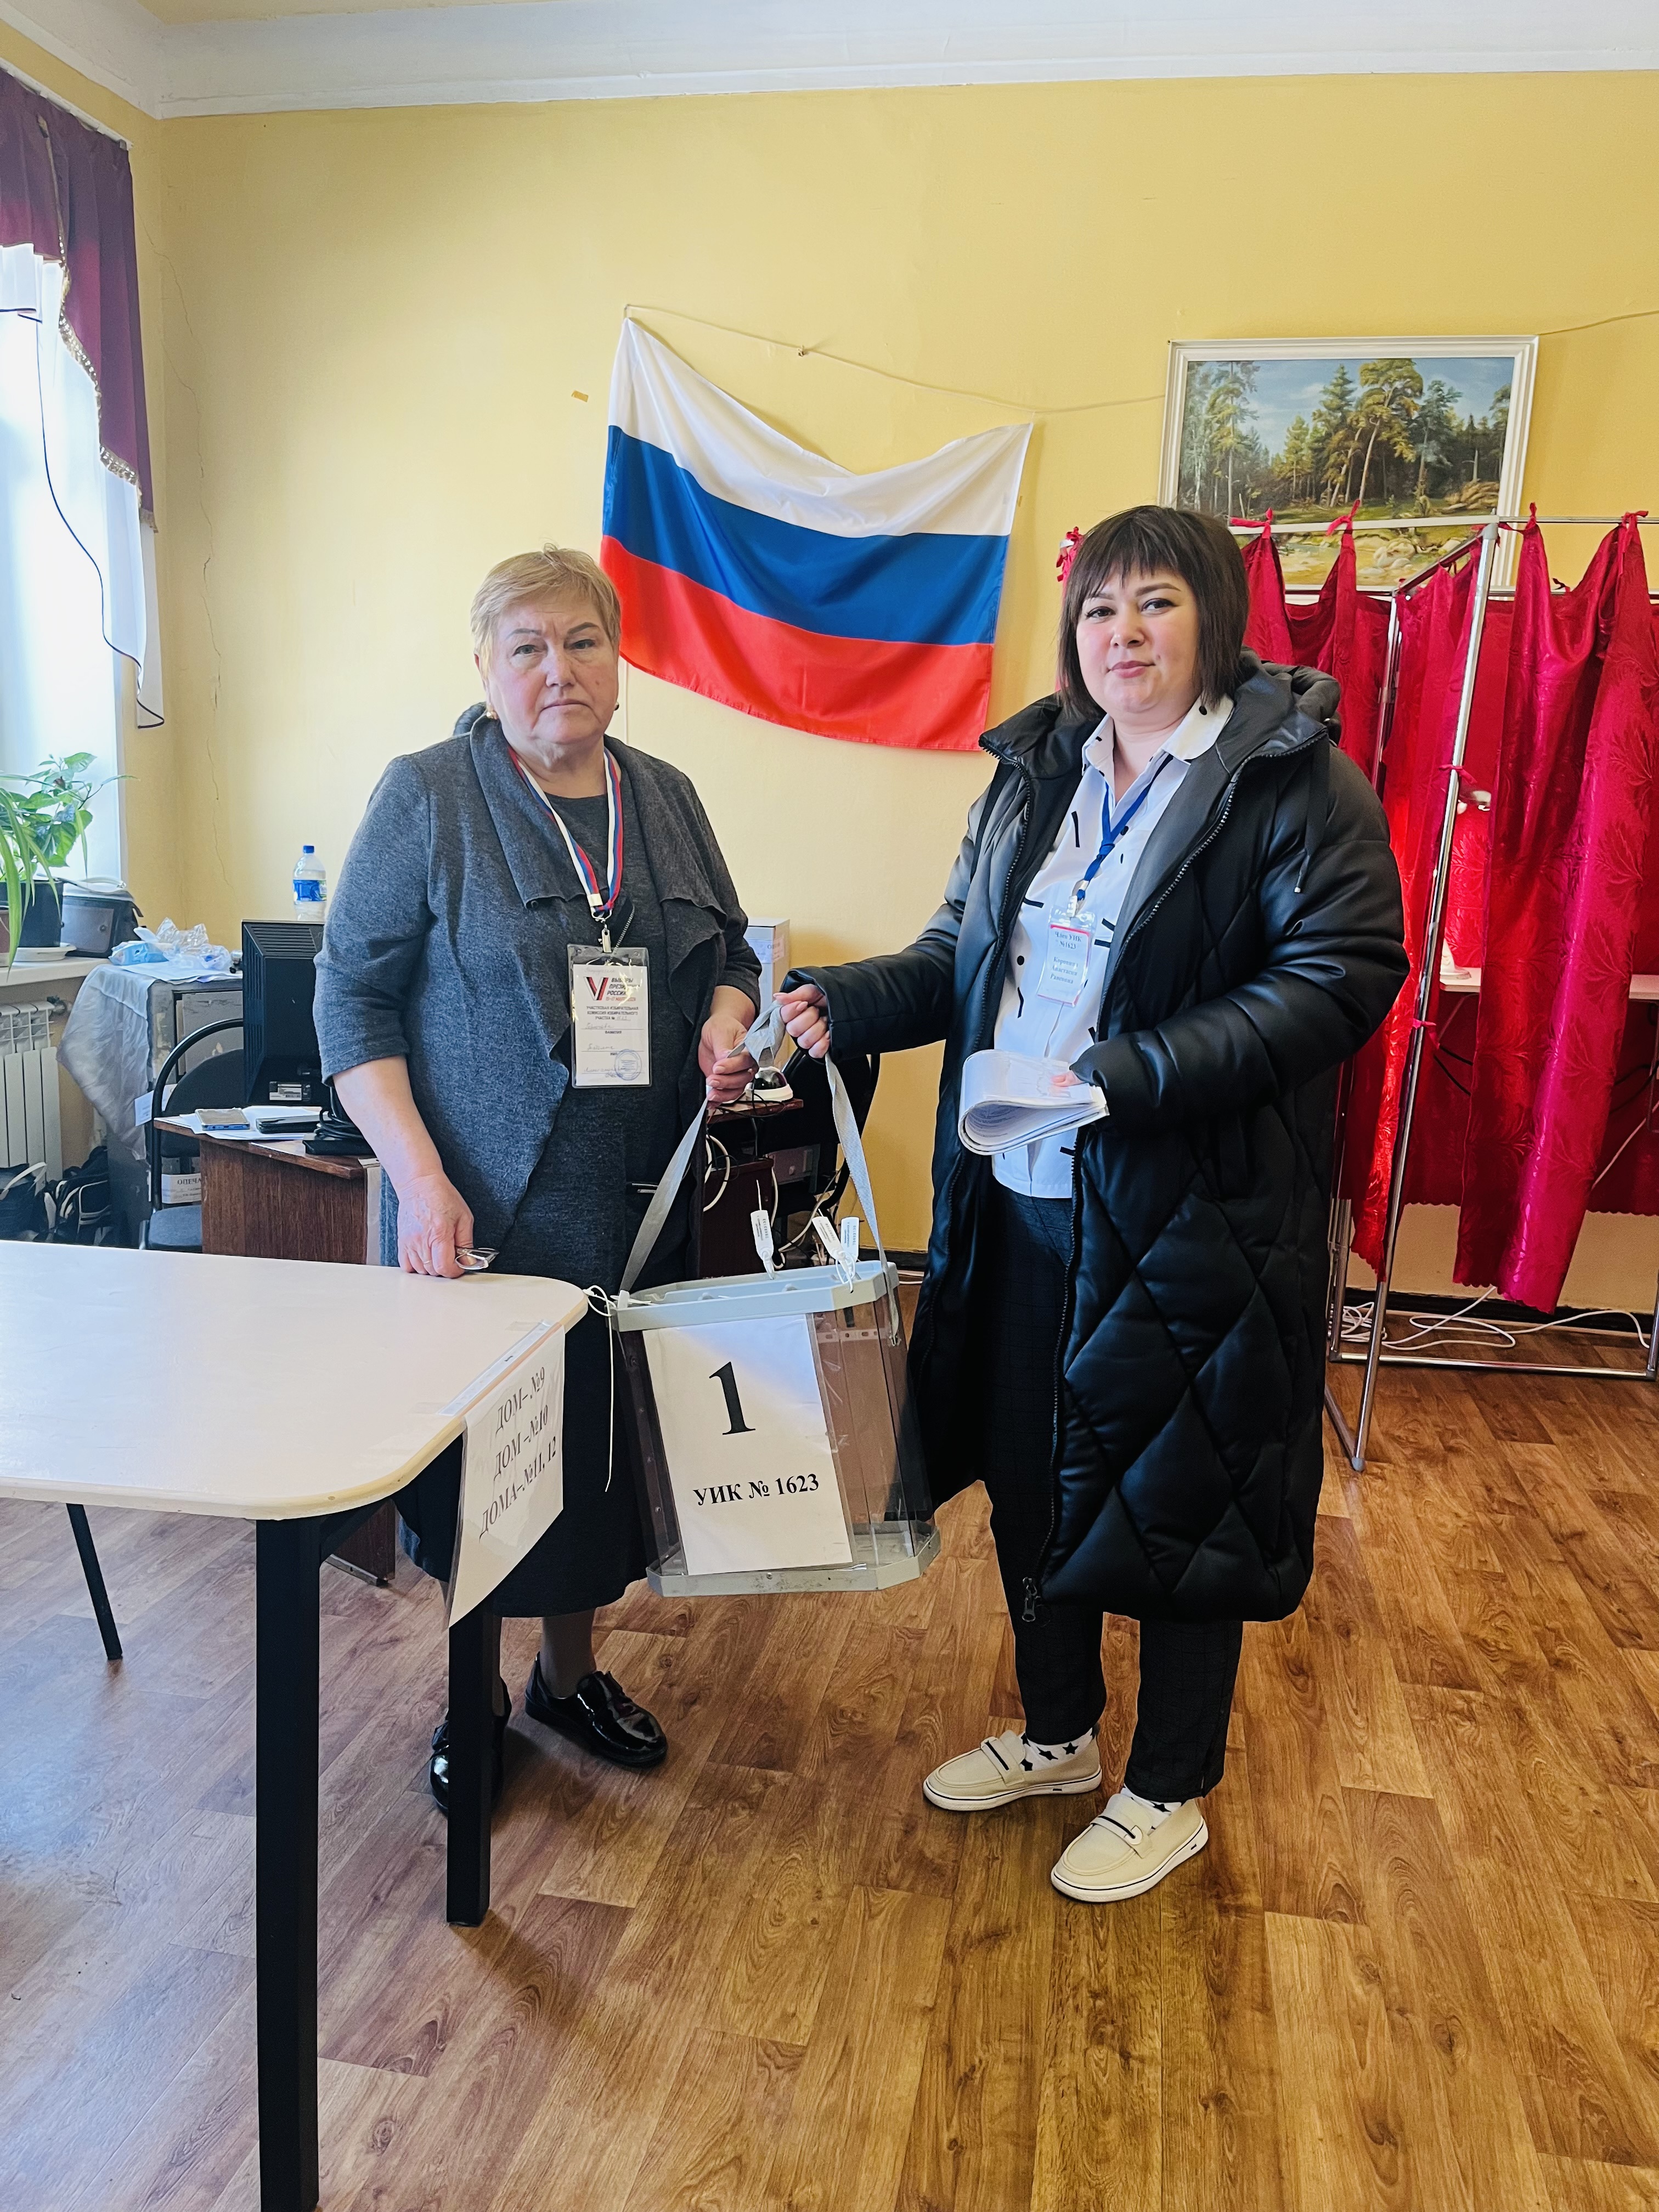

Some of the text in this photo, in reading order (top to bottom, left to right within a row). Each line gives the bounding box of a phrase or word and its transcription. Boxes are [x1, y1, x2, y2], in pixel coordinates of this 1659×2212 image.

[530, 1367, 545, 1400] №9
[709, 1361, 756, 1435] 1
[494, 1432, 521, 1481] ДОМ
[548, 1436, 556, 1463] 12
[692, 1473, 819, 1506] УИК № 1623
